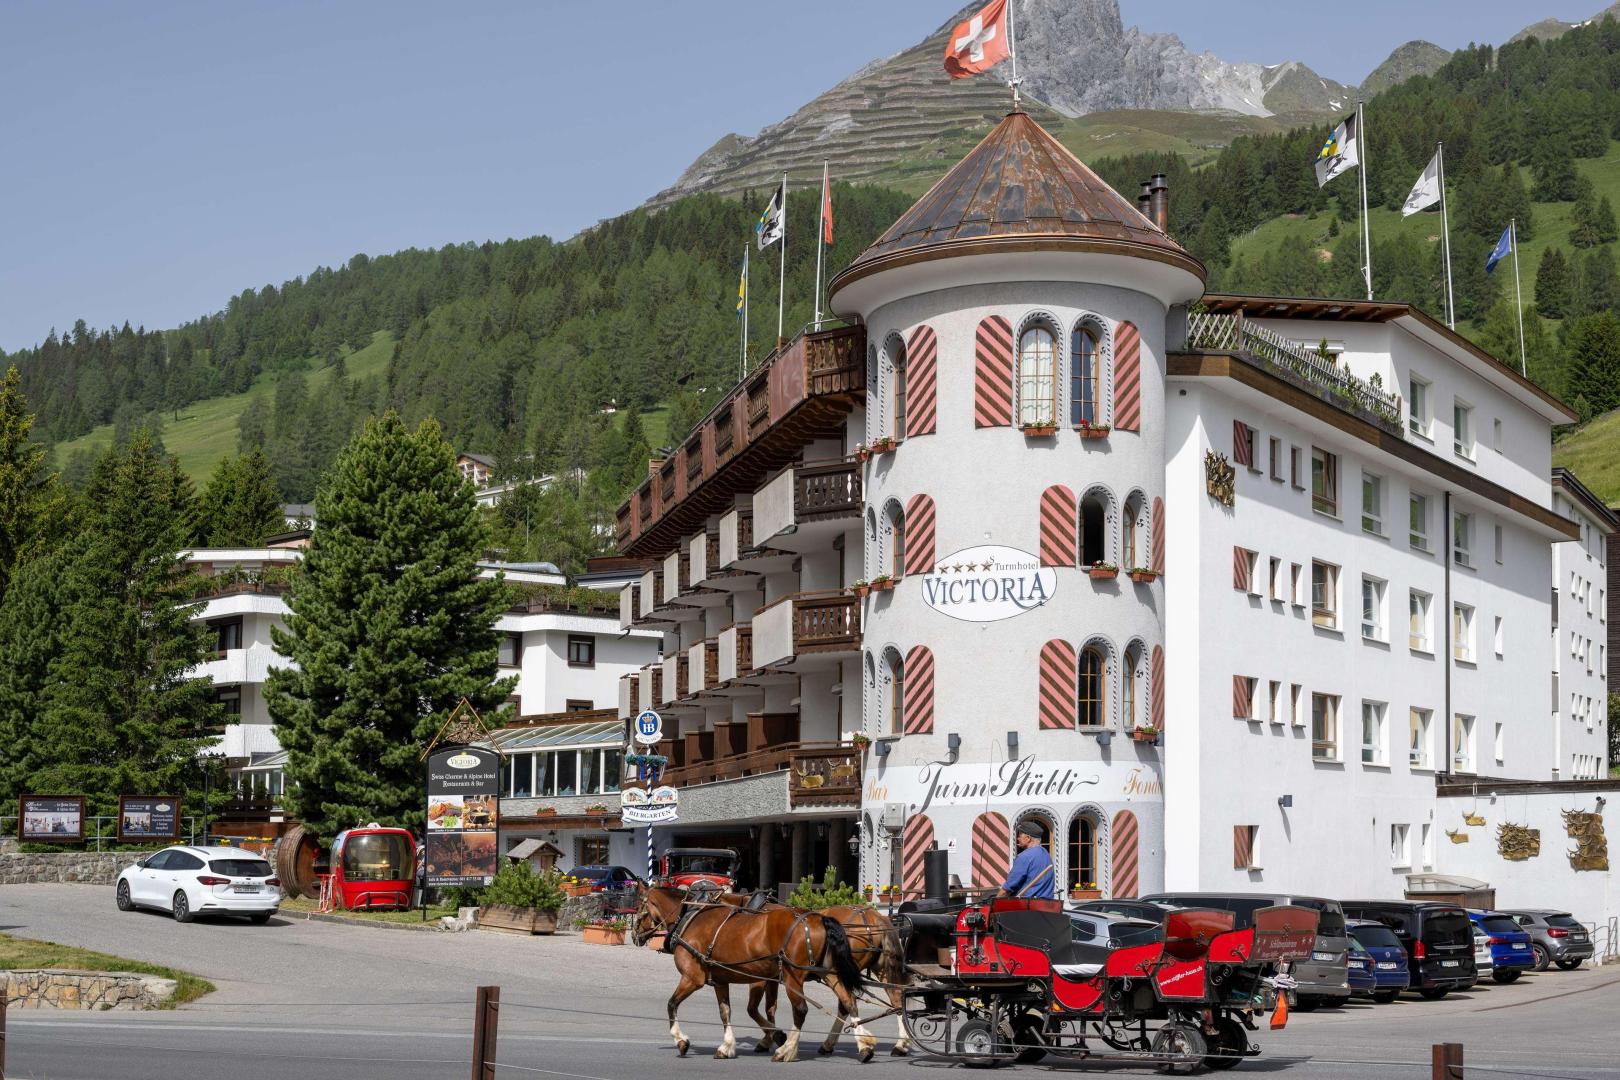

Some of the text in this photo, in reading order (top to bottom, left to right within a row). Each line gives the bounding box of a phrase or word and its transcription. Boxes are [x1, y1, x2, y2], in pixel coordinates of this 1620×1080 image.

[995, 561, 1039, 571] Turmhotel
[924, 572, 1048, 609] VICTORIA
[629, 810, 671, 819] BIERGARTEN
